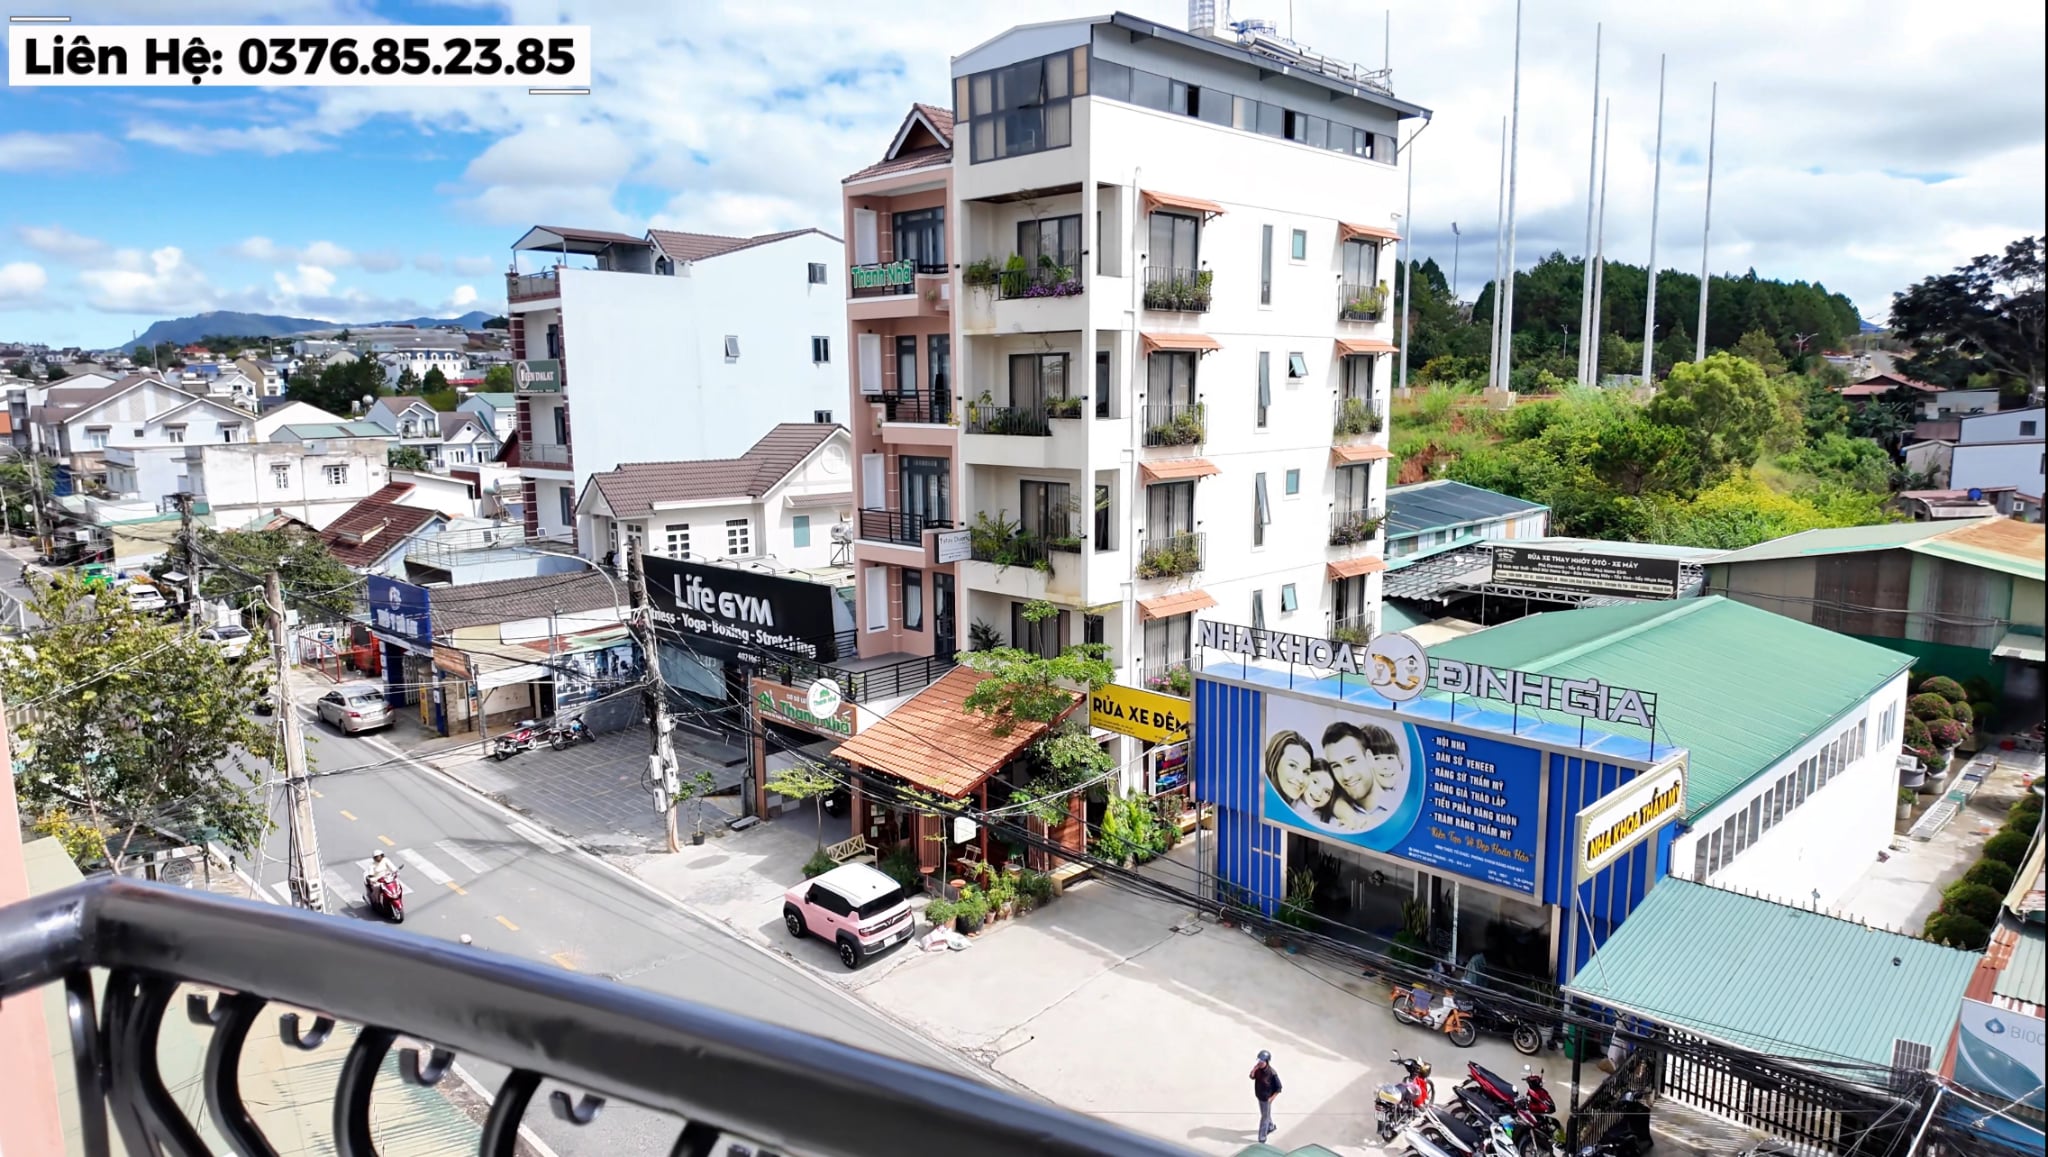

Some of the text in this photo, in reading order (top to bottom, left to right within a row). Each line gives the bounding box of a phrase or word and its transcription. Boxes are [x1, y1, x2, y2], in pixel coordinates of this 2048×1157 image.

[851, 264, 885, 288] Thanh
[1552, 555, 1570, 563] THAY
[673, 573, 775, 627] Life GYM
[681, 612, 707, 634] Yoga
[711, 620, 749, 644] Boxing
[1198, 619, 1359, 675] NHA KHOA
[1093, 695, 1125, 719] RỬA
[1128, 705, 1149, 725] XE
[1153, 711, 1190, 736] ĐÊM
[1436, 736, 1466, 751] NỘI NHA
[1466, 758, 1495, 774] VENEER
[1587, 830, 1612, 861] NHA
[1611, 811, 1640, 846] KHOA
